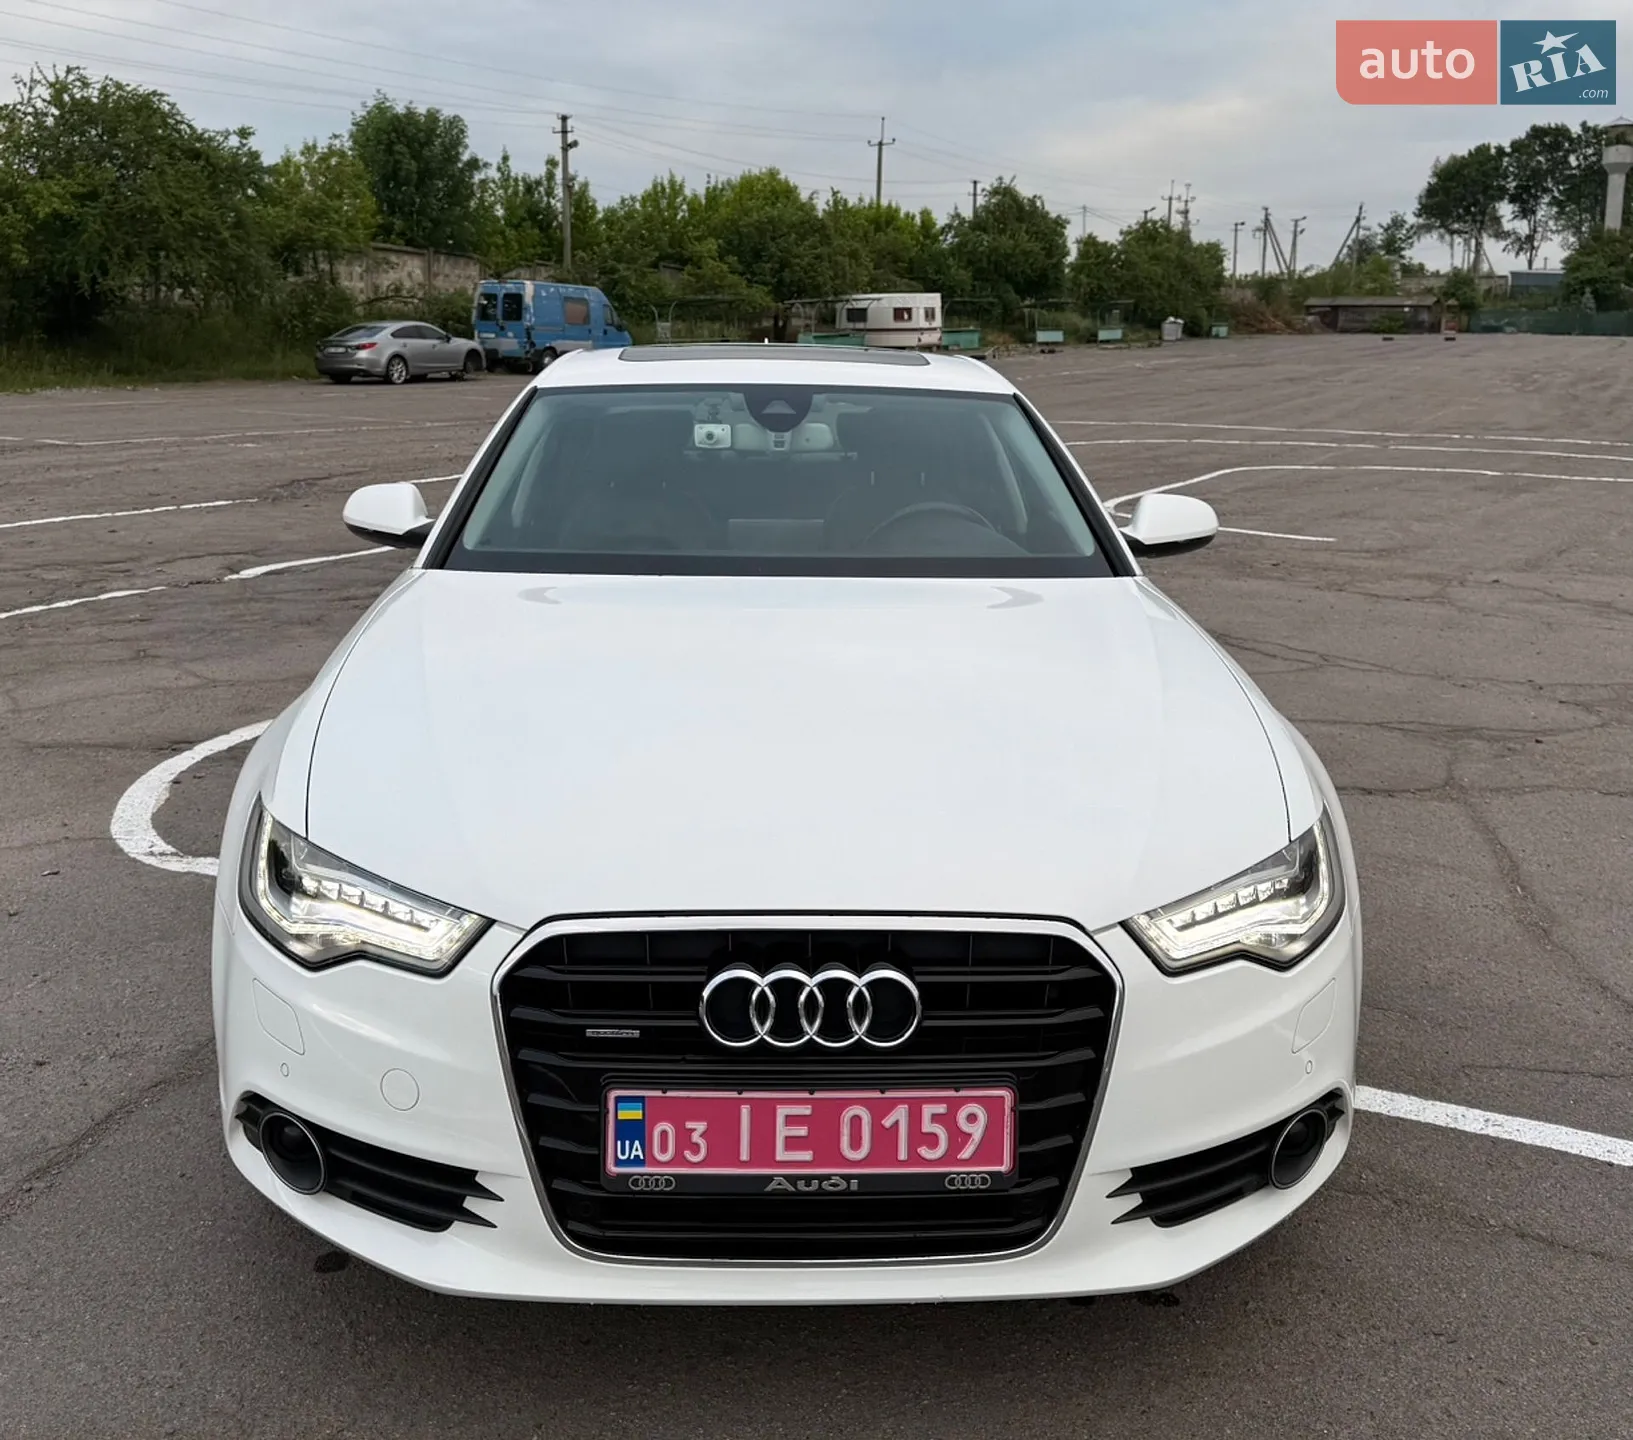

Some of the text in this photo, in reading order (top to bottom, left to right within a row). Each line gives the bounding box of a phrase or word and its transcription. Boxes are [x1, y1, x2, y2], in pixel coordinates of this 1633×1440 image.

[652, 1103, 988, 1163] 03 IE 0159
[616, 1140, 644, 1160] UA
[764, 1176, 859, 1192] Audi
